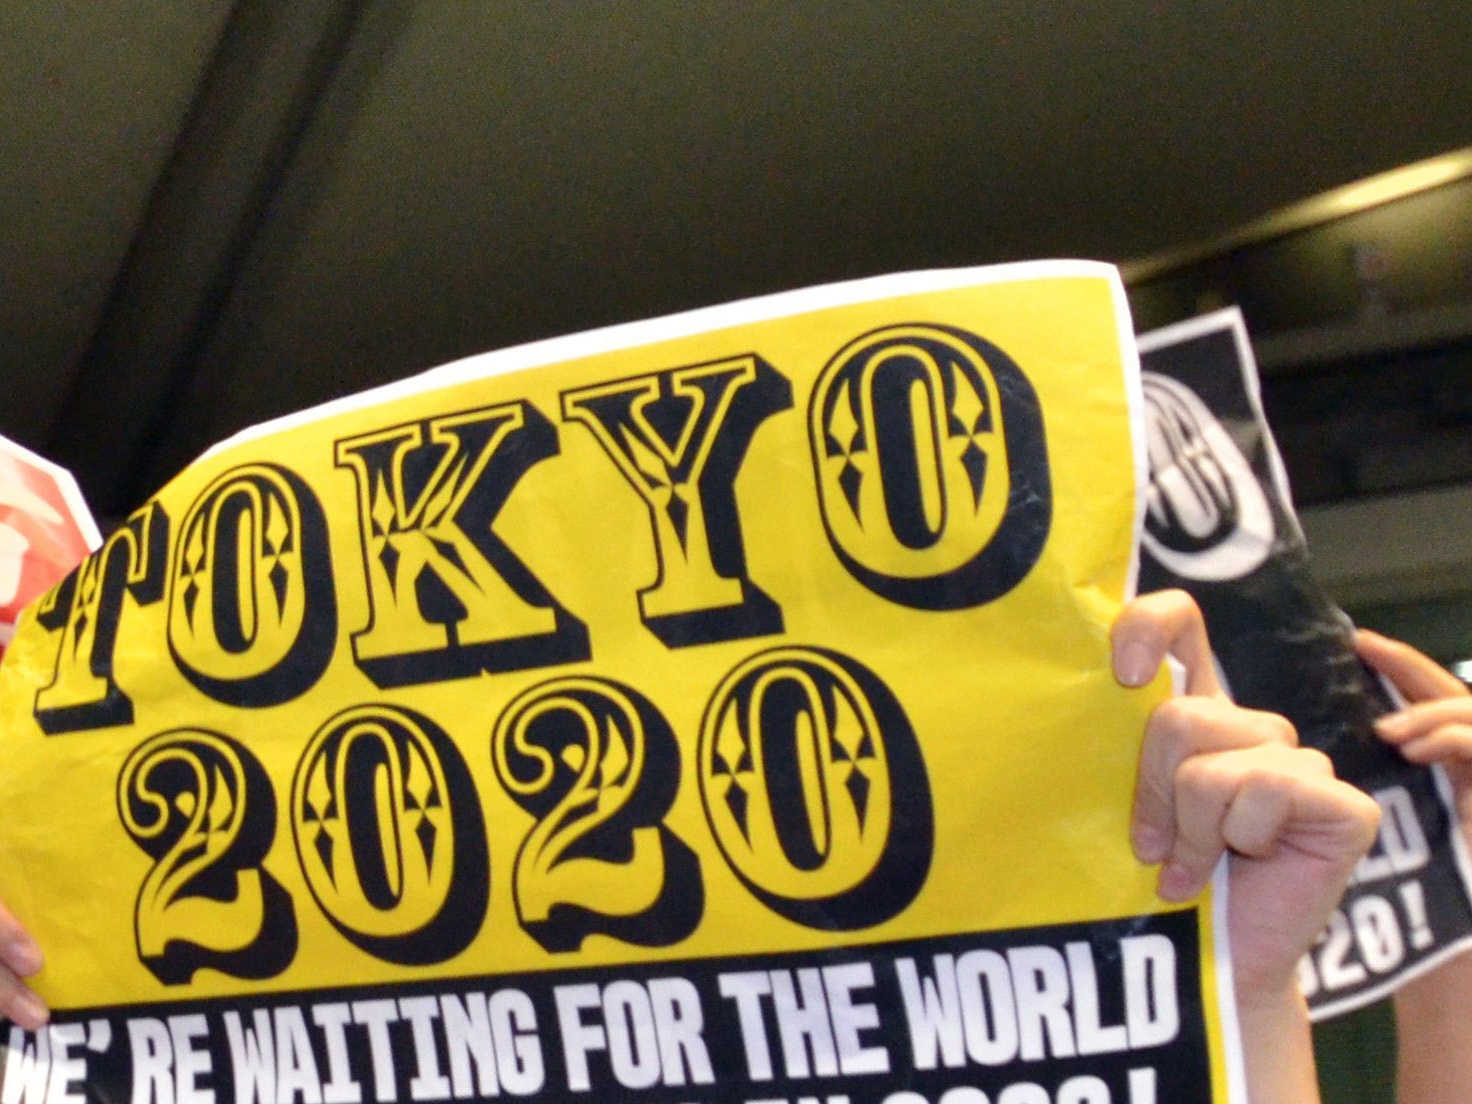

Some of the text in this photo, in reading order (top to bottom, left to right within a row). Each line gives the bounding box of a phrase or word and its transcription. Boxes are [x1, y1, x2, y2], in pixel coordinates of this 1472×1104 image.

[33, 322, 1054, 735] TOKYO
[116, 644, 936, 986] 2020
[552, 976, 716, 1092] FOR
[717, 961, 891, 1082] THE
[895, 933, 1181, 1071] WORLD
